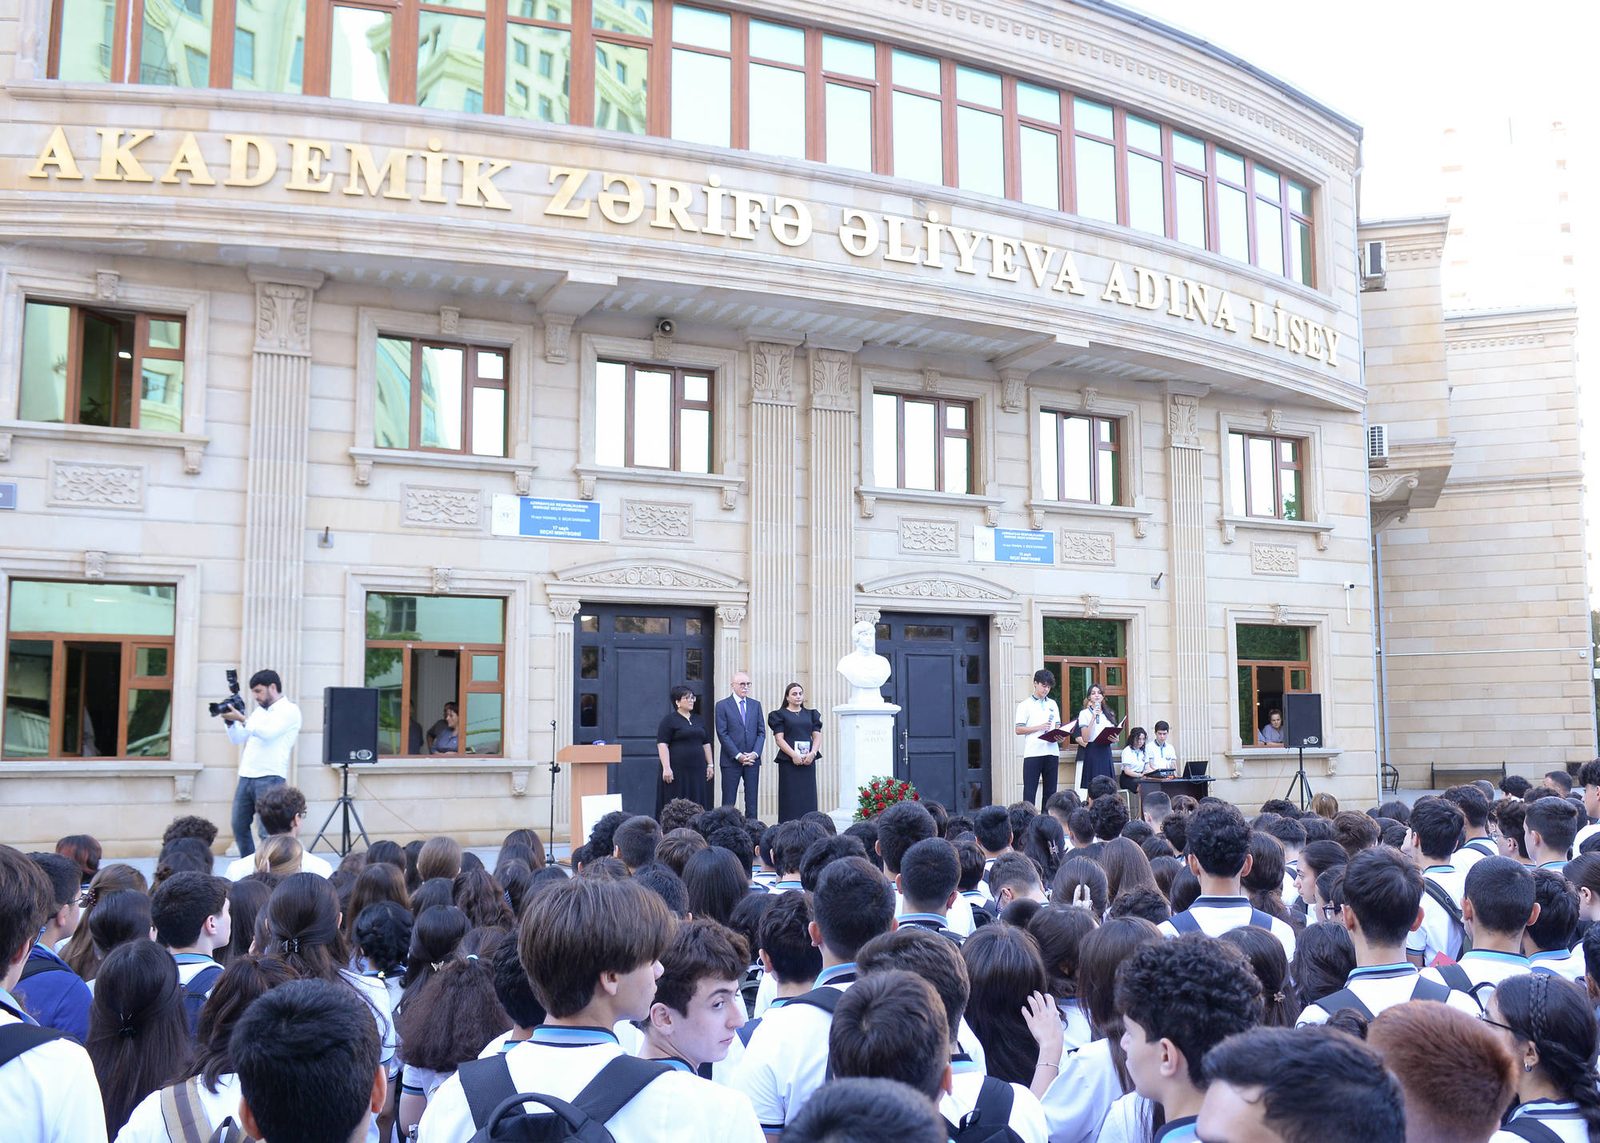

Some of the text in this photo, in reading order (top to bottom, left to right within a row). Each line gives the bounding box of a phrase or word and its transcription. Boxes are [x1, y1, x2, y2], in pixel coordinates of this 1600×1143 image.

[28, 126, 1342, 367] AKADEMİK ZƏRİFƏ ƏLİYEVA ADINA LİSEY
